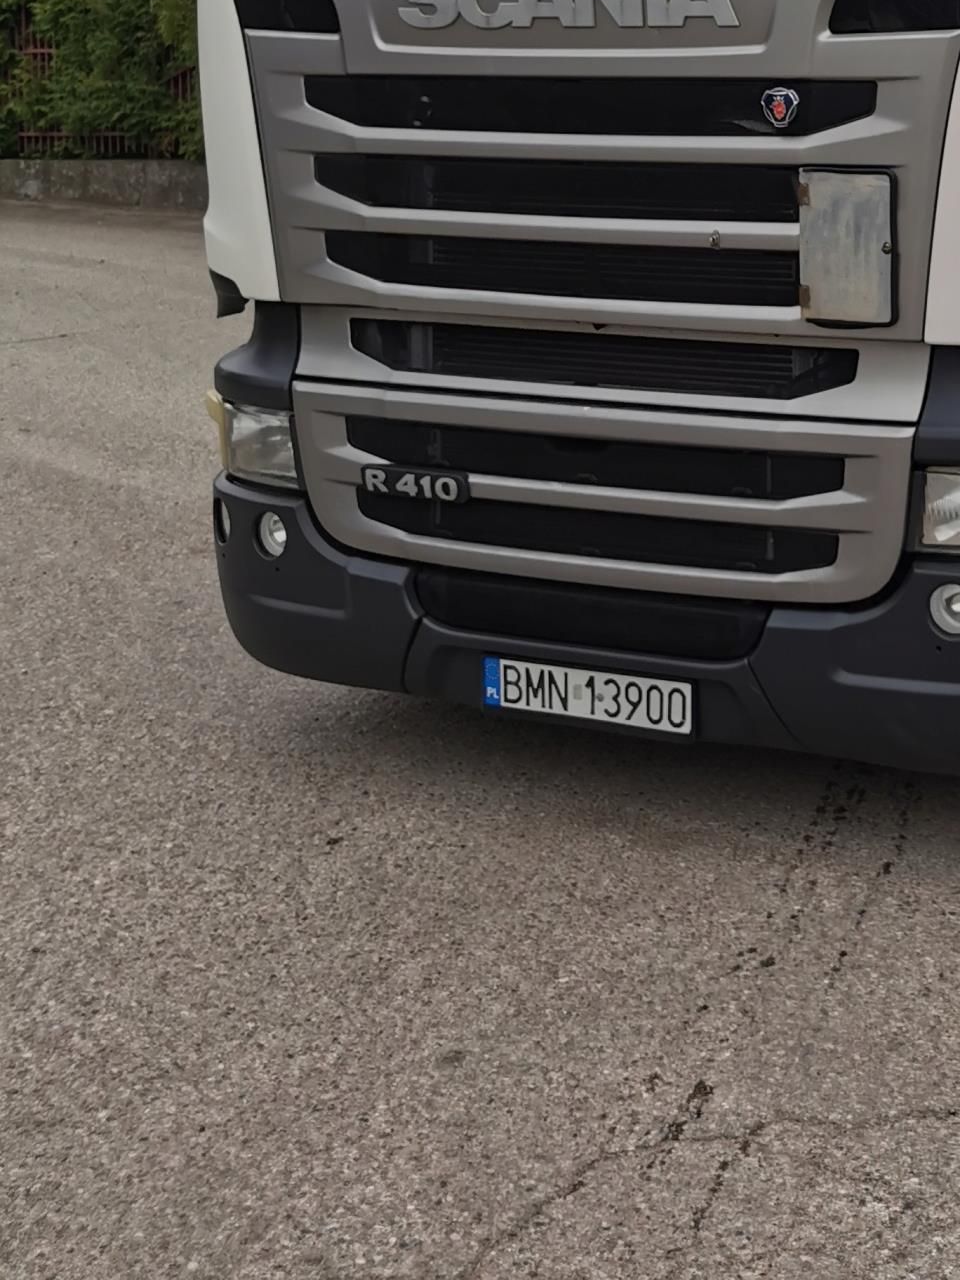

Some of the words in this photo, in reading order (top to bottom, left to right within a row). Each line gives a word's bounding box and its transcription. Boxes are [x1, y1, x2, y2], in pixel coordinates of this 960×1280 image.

[364, 468, 389, 493] R
[395, 473, 459, 501] 410
[486, 686, 499, 699] PL
[503, 664, 569, 712] BMN
[585, 675, 687, 729] 13900
